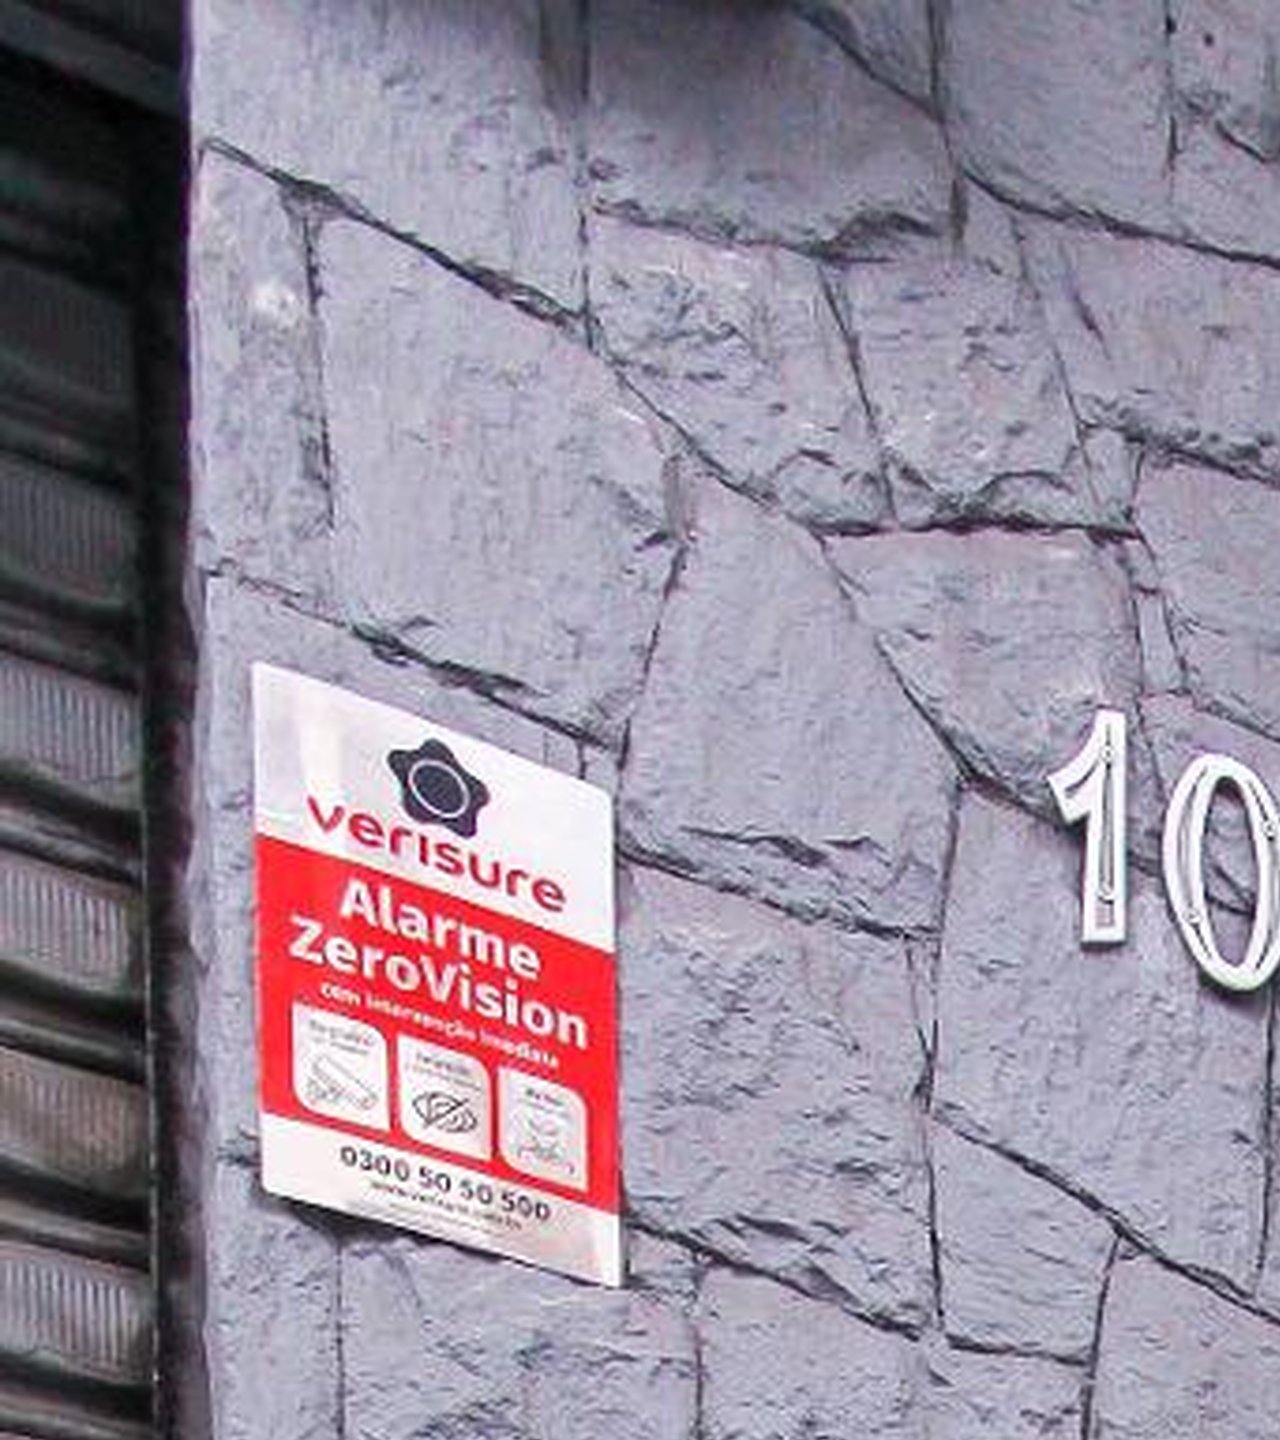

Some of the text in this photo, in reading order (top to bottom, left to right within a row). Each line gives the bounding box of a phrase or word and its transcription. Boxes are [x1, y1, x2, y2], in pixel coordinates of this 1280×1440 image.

[307, 796, 567, 912] verisure
[289, 914, 589, 1048] ZeroVision
[340, 878, 541, 980] Alarme
[341, 1146, 410, 1182] 0300
[418, 1165, 451, 1194] 50
[458, 1179, 493, 1206] 50
[501, 1189, 551, 1222] 500
